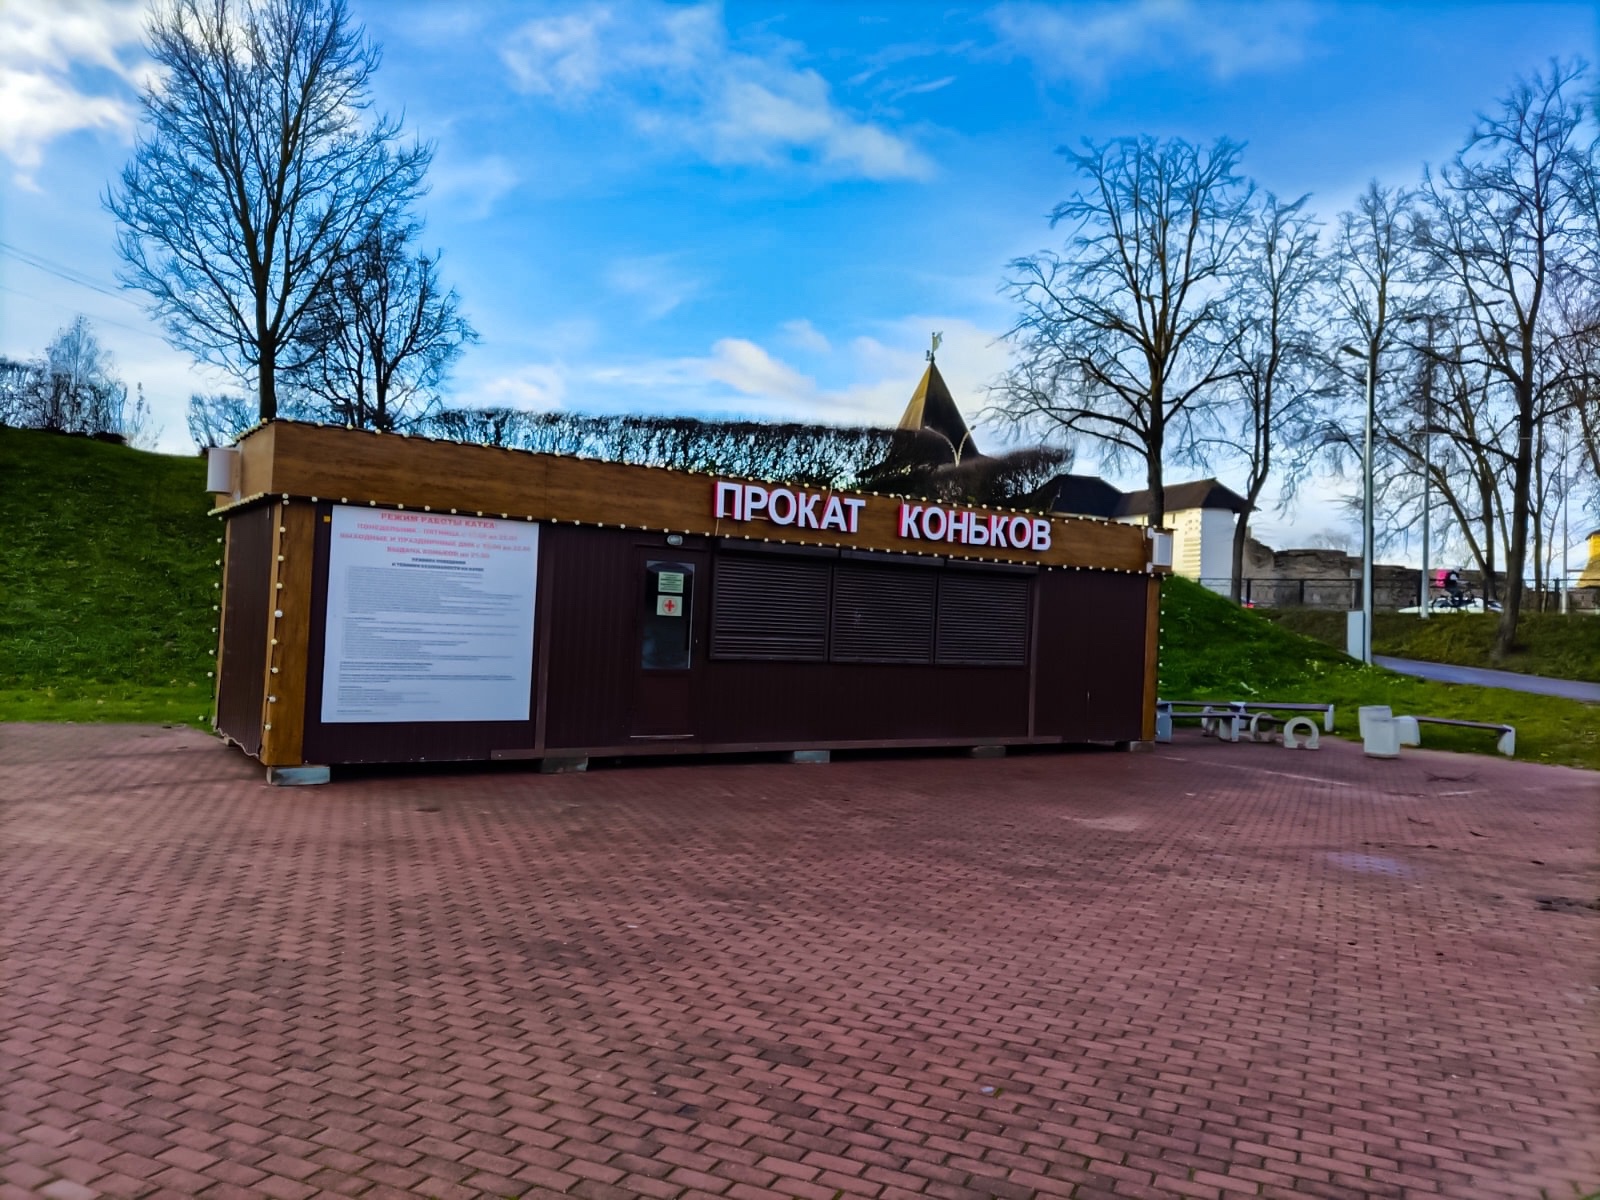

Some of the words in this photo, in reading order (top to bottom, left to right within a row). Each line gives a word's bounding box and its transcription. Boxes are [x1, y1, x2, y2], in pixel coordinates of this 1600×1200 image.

[421, 515, 462, 526] РАБОТЫ
[714, 481, 866, 533] ПРОКАТ
[898, 503, 1052, 551] КОНЬКОВ
